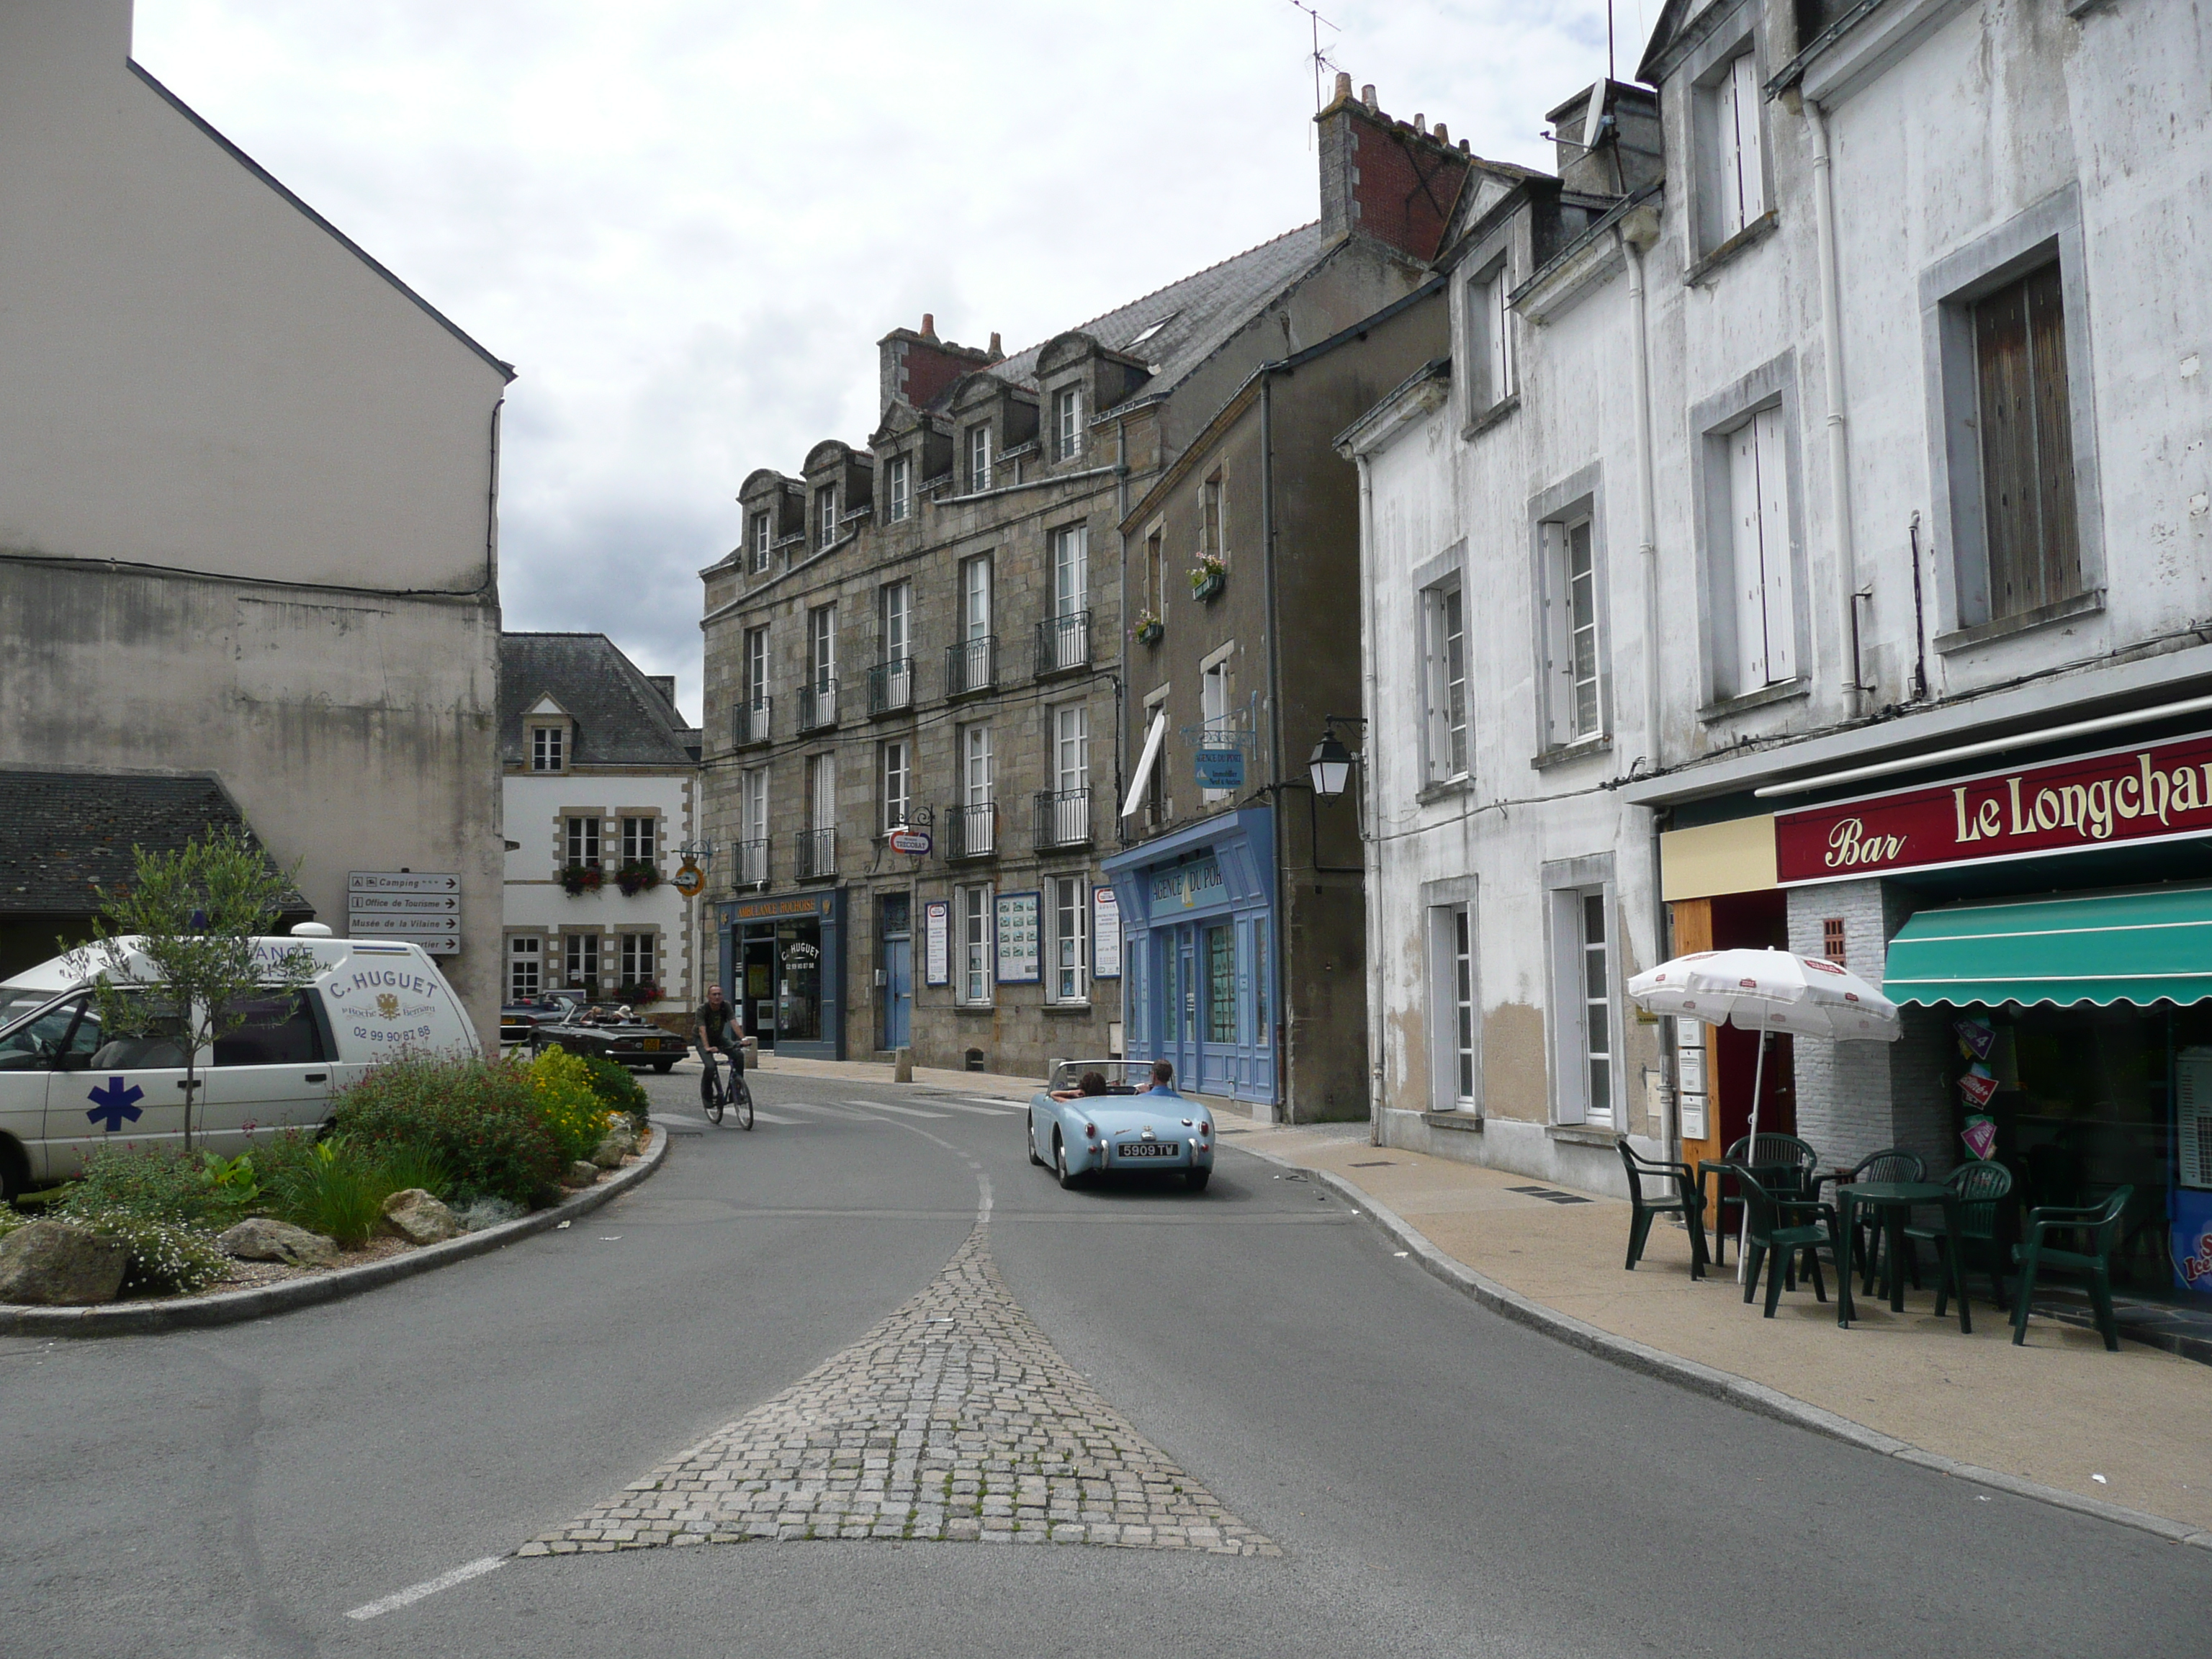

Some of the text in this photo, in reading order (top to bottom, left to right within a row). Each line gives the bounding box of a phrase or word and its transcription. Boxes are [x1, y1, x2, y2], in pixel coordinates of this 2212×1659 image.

[1953, 787, 2001, 843] Le
[1825, 818, 1907, 868] Bar
[379, 878, 419, 888] Camping
[1153, 864, 1223, 902] AGENCE DU POR
[738, 899, 814, 917] AMBULANCE ROCHOISE
[781, 943, 819, 961] C. HUGUET
[330, 971, 438, 998] C. HUGUET
[354, 1025, 431, 1042] 02 99 90 87 88
[1124, 1145, 1173, 1156] 5909 TW
